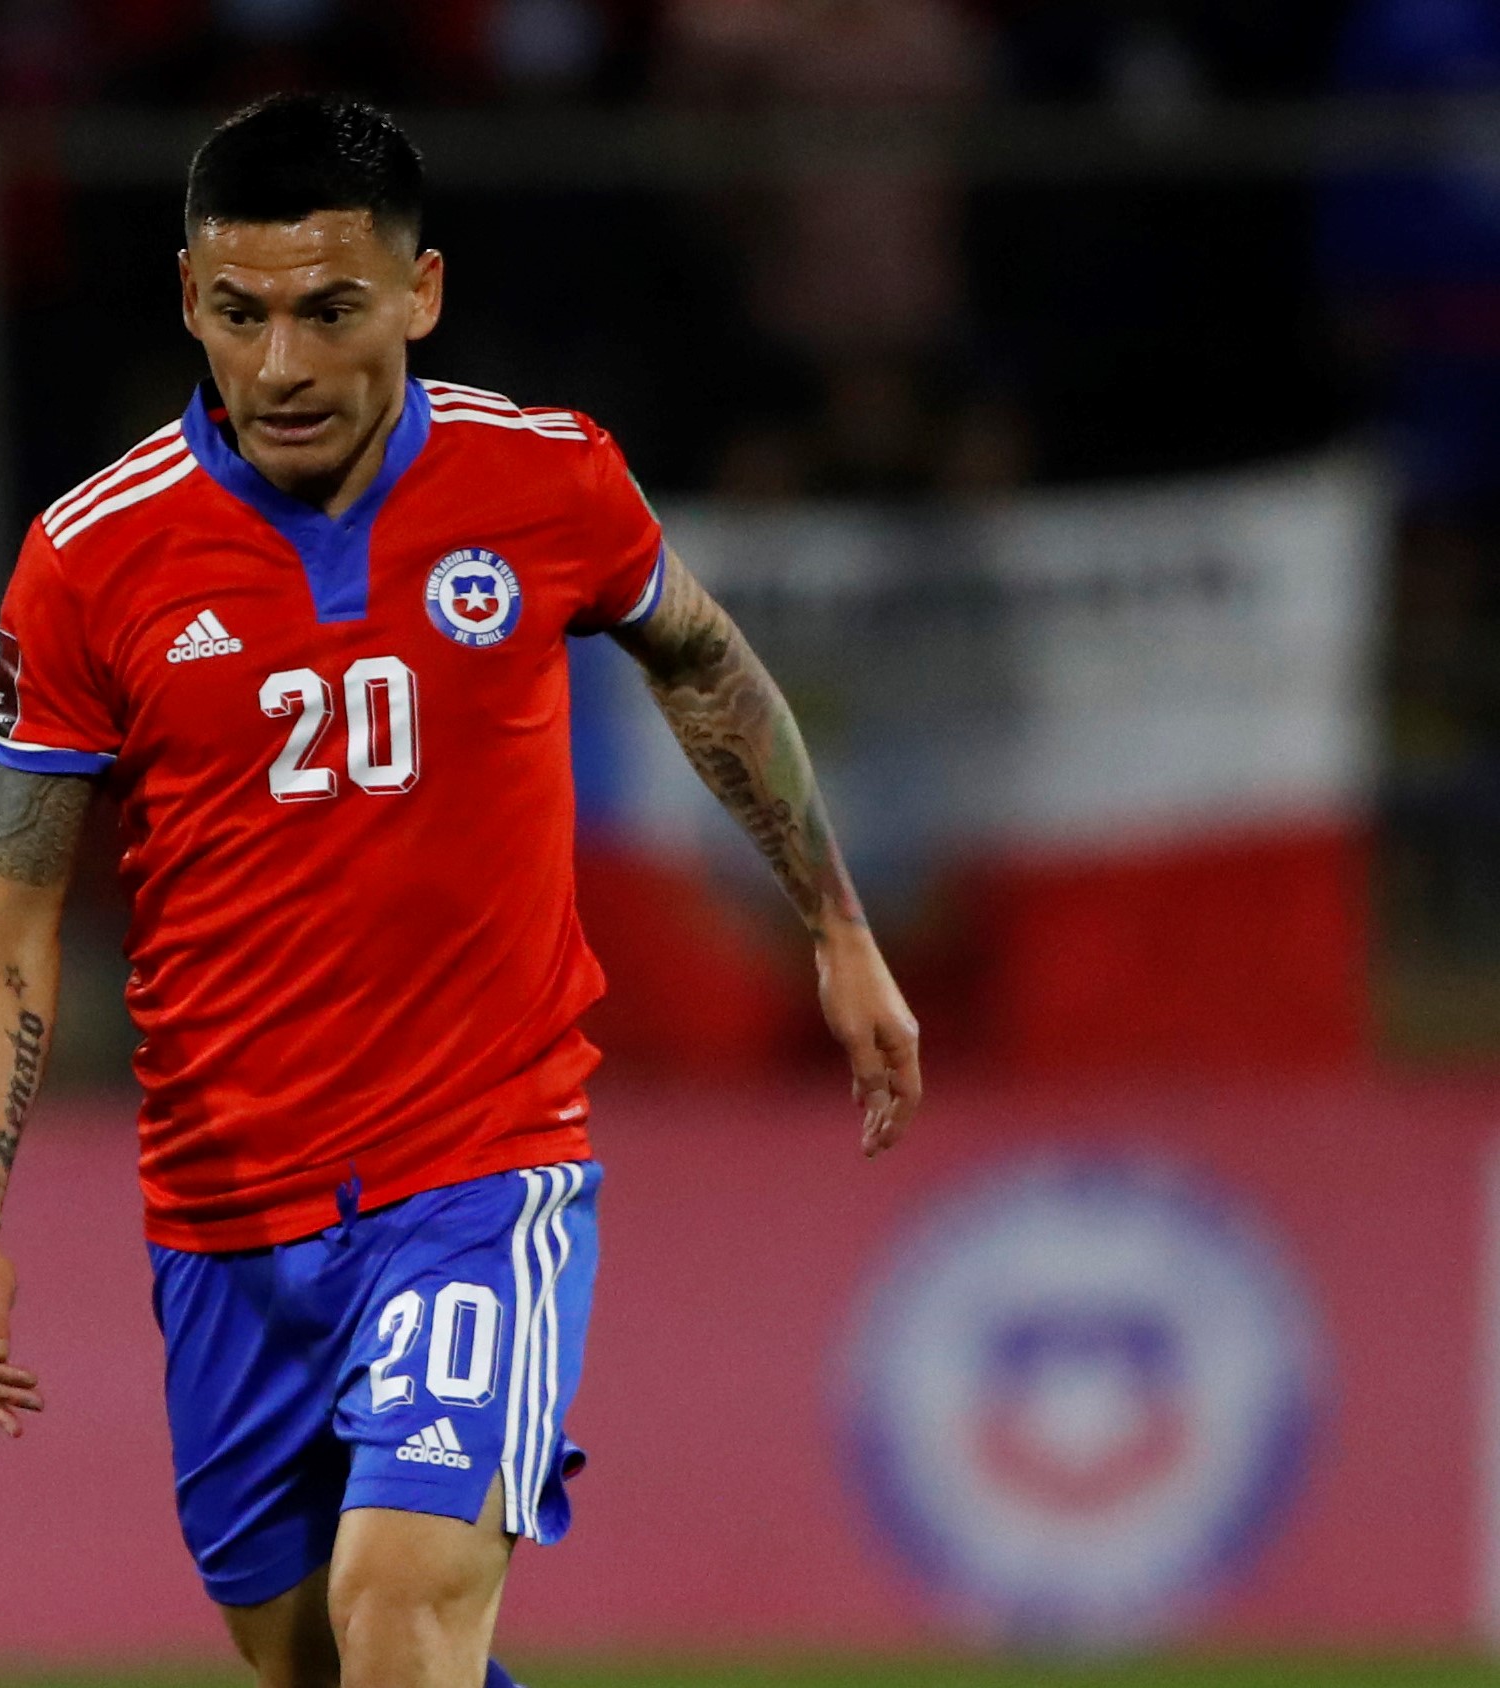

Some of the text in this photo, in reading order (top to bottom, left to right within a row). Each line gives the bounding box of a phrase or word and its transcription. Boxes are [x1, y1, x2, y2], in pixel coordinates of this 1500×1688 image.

[166, 637, 243, 664] adidas
[454, 628, 504, 646] DE CHILE
[258, 655, 420, 804] 20
[369, 1281, 504, 1415] 20
[396, 1444, 472, 1470] adidas
